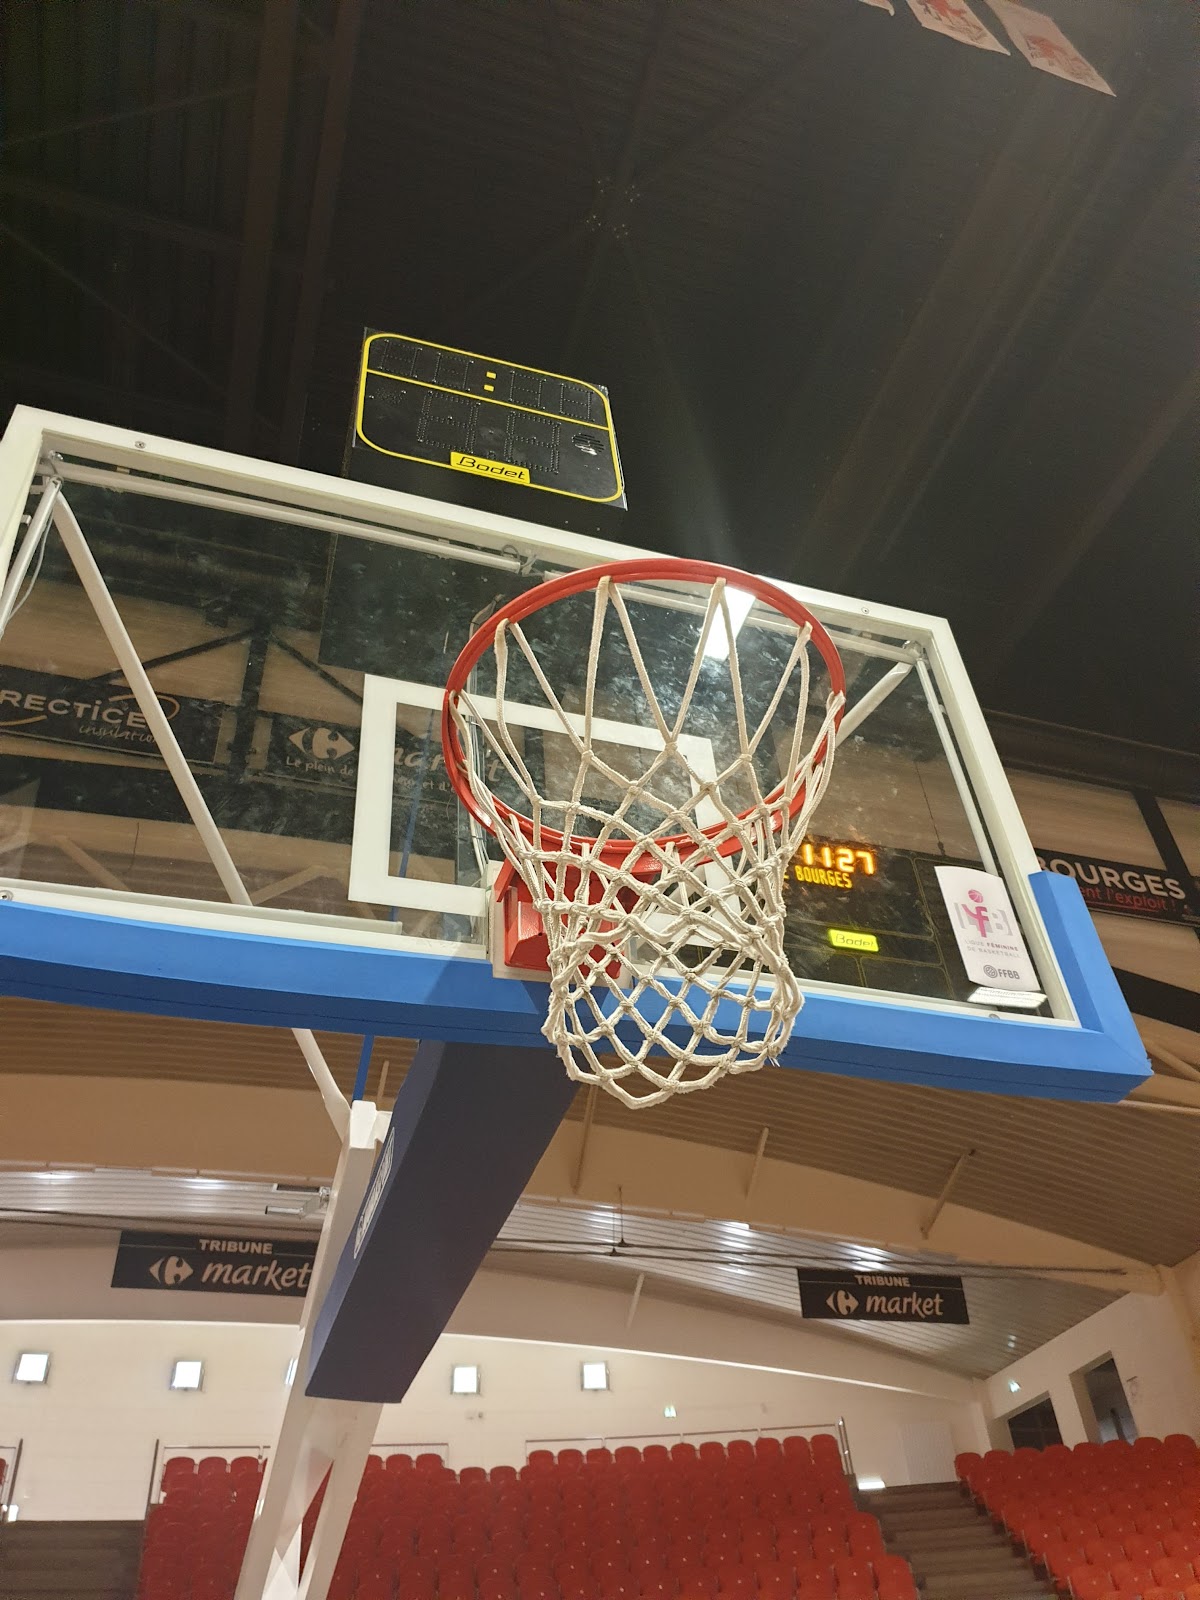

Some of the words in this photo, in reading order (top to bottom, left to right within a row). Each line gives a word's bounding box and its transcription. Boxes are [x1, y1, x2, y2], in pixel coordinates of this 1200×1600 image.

[456, 456, 525, 480] Bodet
[0, 689, 153, 729] RECTICE
[795, 865, 852, 889] BOURGES
[997, 968, 1020, 980] FFBB
[199, 1239, 272, 1254] TRIBUNE
[202, 1260, 312, 1290] market
[854, 1274, 911, 1287] TRIBUNE
[865, 1292, 944, 1319] market
